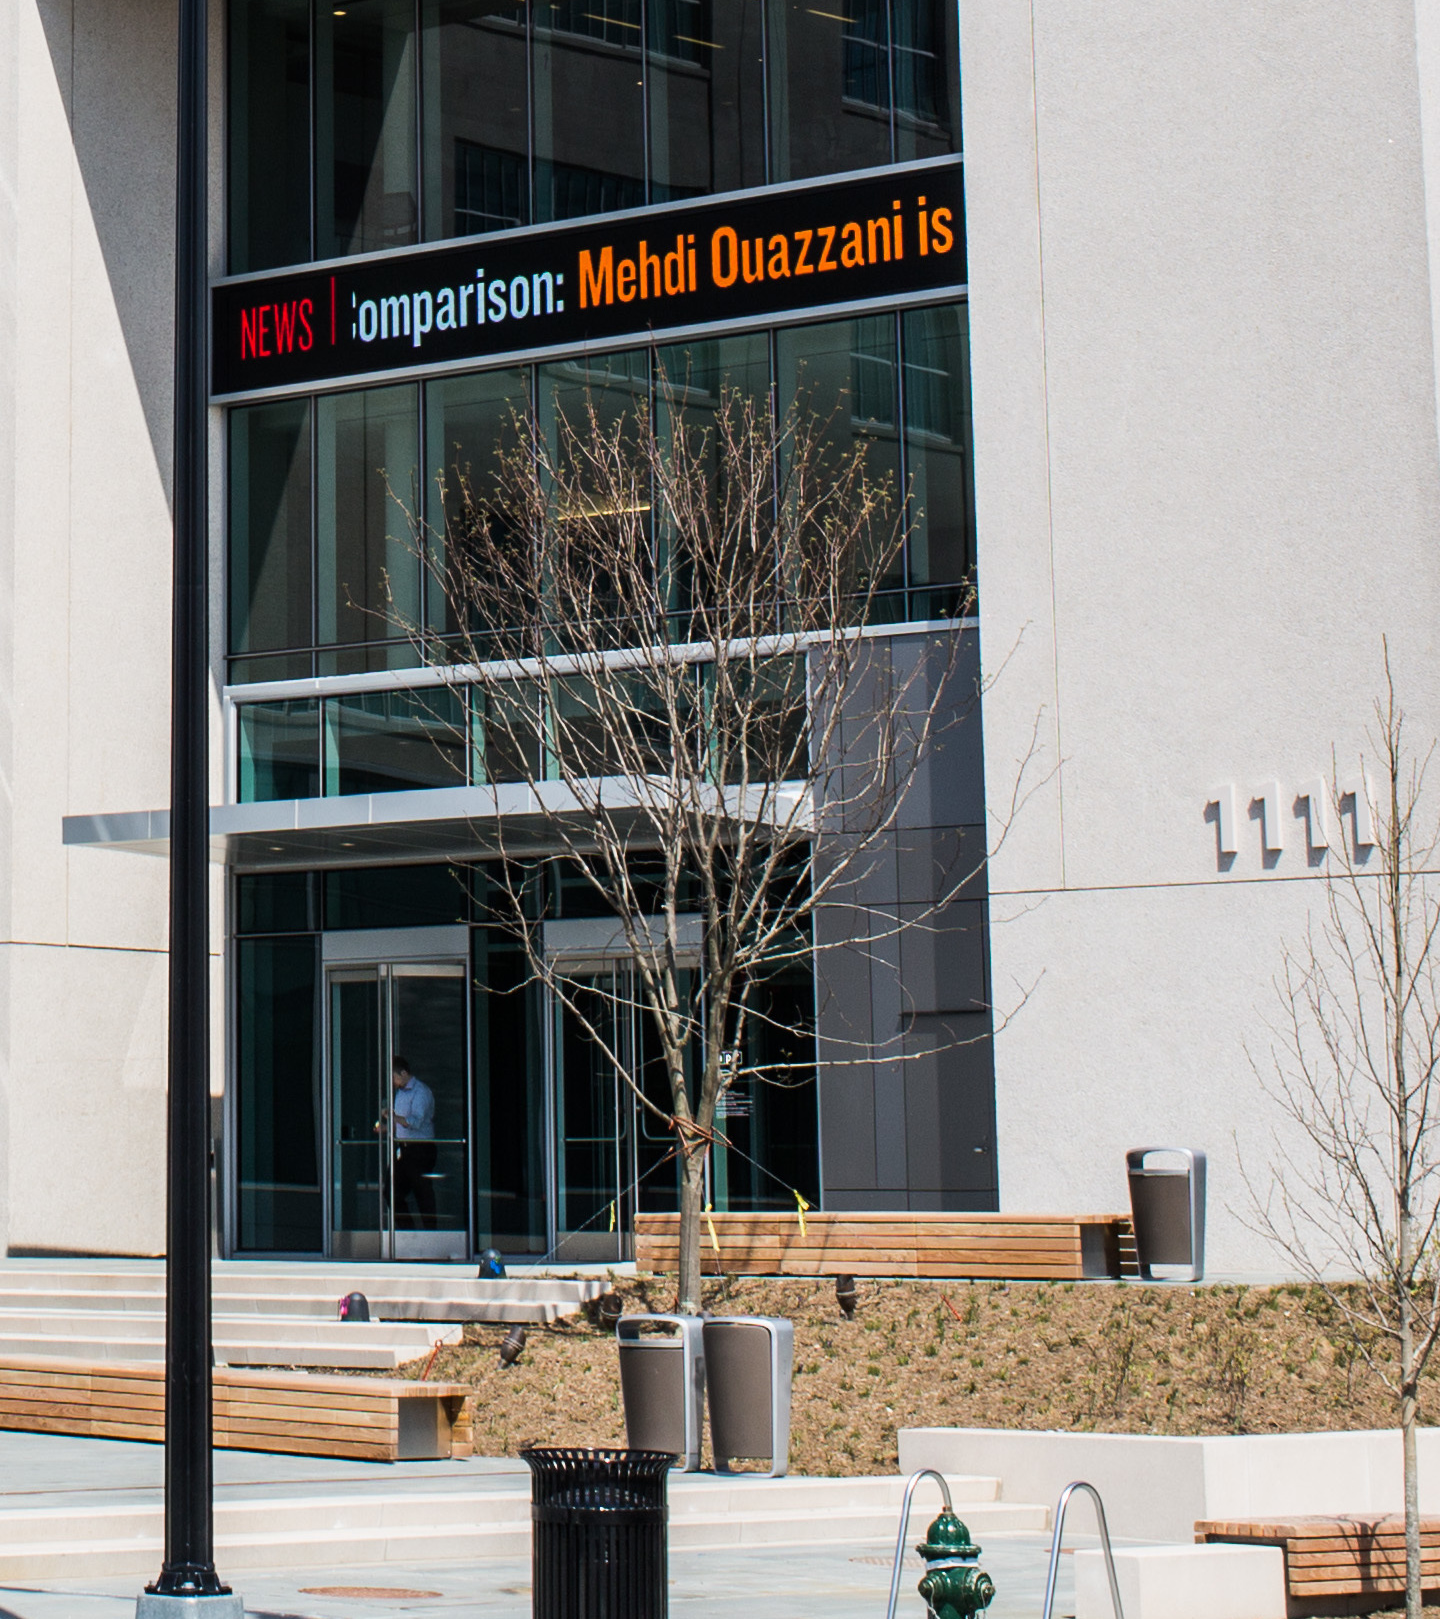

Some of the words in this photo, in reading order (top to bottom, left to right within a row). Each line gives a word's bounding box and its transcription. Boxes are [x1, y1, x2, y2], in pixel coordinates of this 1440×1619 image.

[241, 298, 313, 361] NEWS
[352, 267, 565, 348] omparison:
[578, 233, 697, 310] Mehdi
[710, 199, 904, 289] Ouazzani
[917, 195, 954, 256] is
[1204, 776, 1376, 862] 1111
